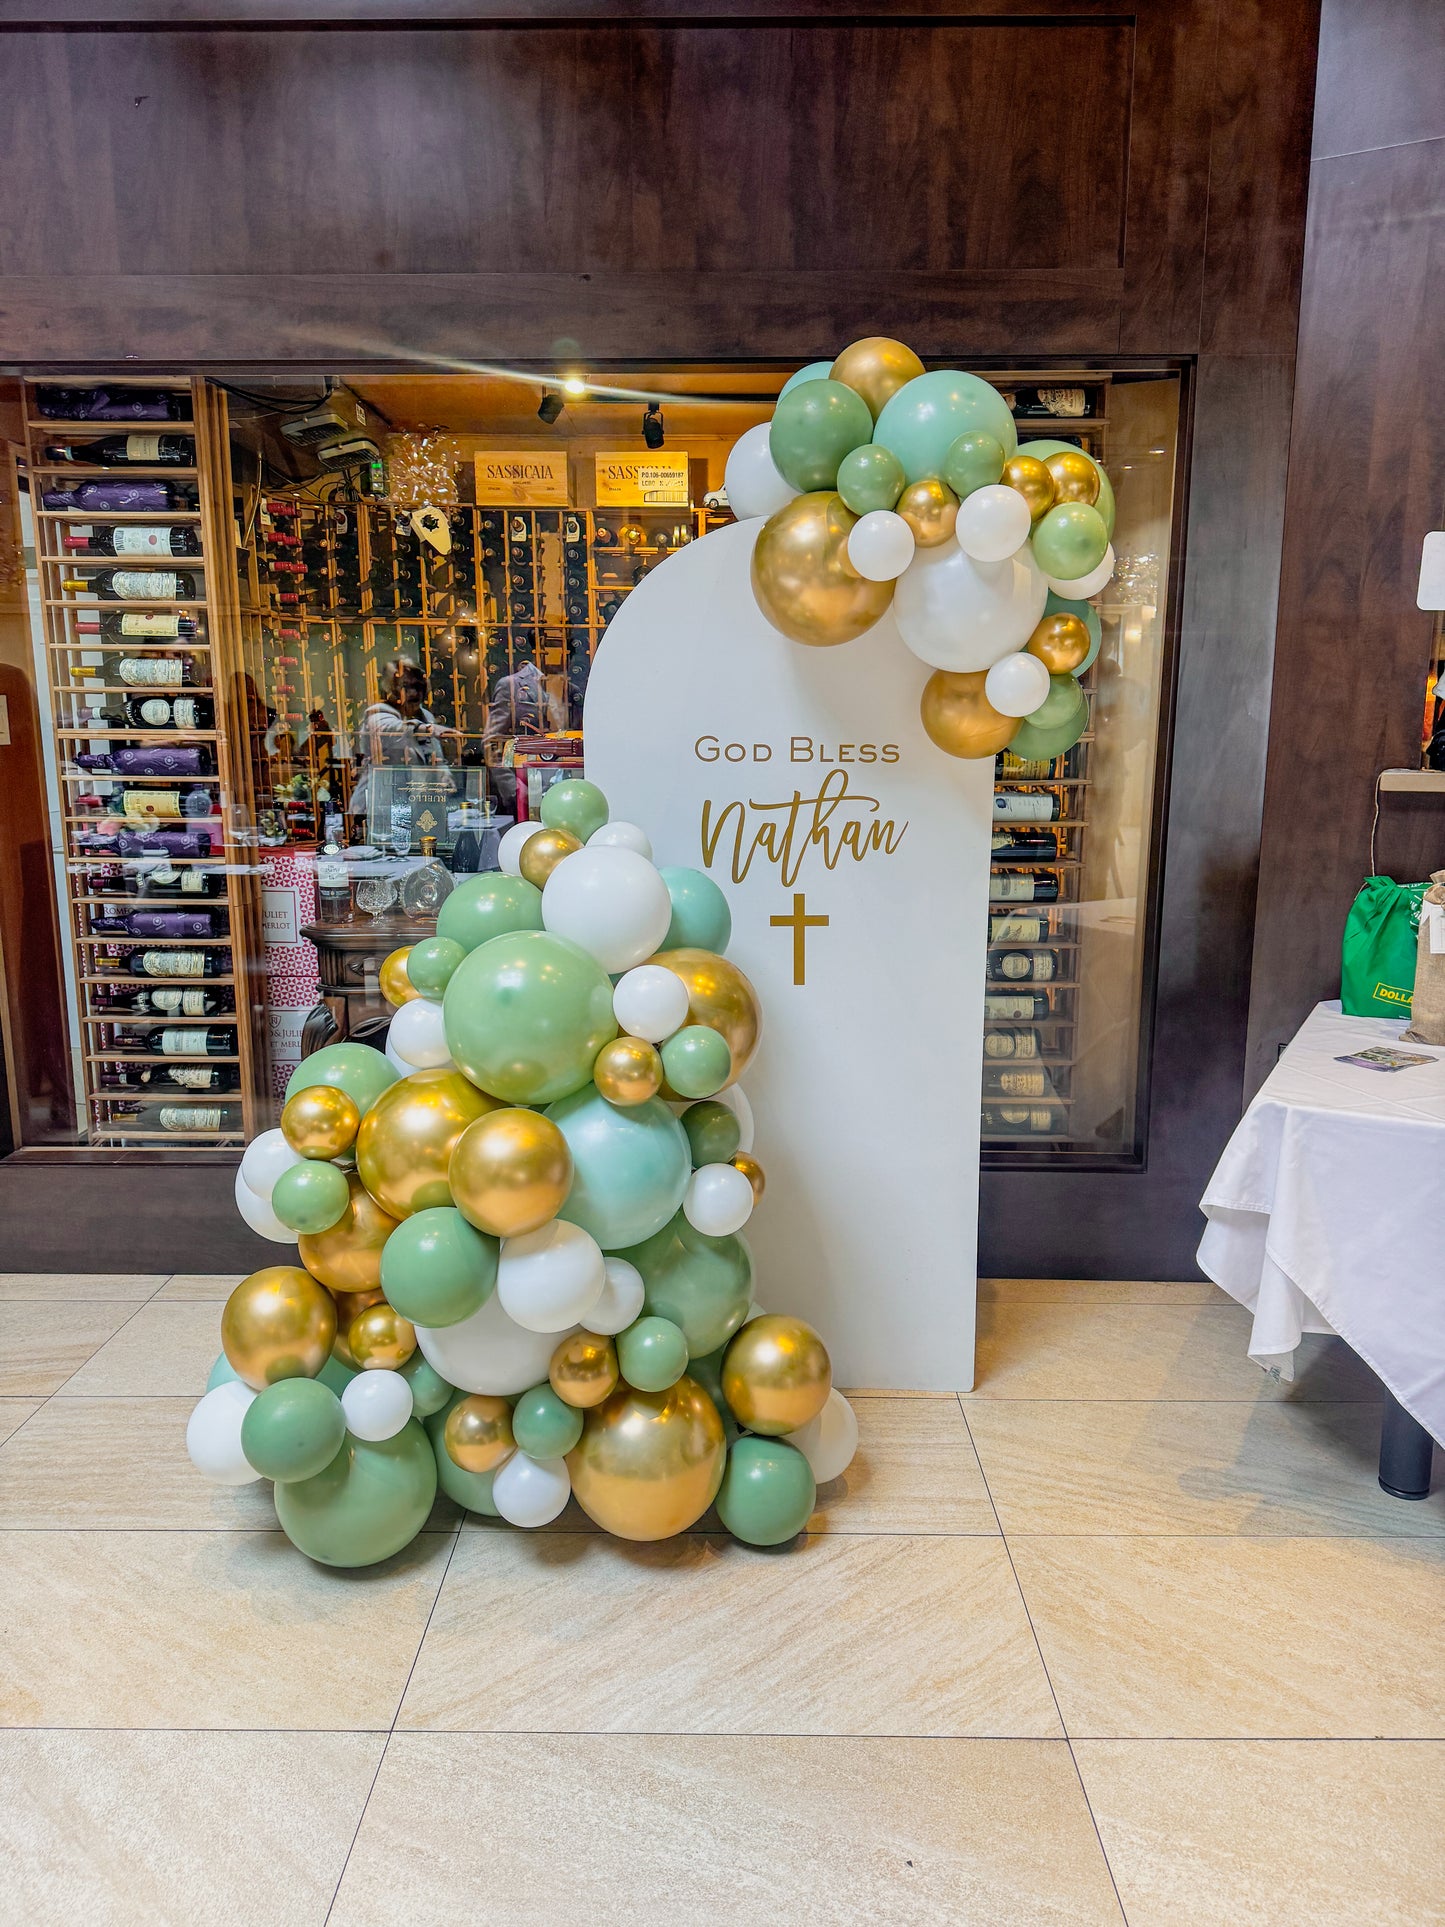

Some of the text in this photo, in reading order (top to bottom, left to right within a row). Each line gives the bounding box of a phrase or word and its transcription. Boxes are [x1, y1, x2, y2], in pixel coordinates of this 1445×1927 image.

[487, 465, 553, 479] SASSICAIA
[701, 768, 909, 888] Nathan
[263, 911, 288, 919] ULIET
